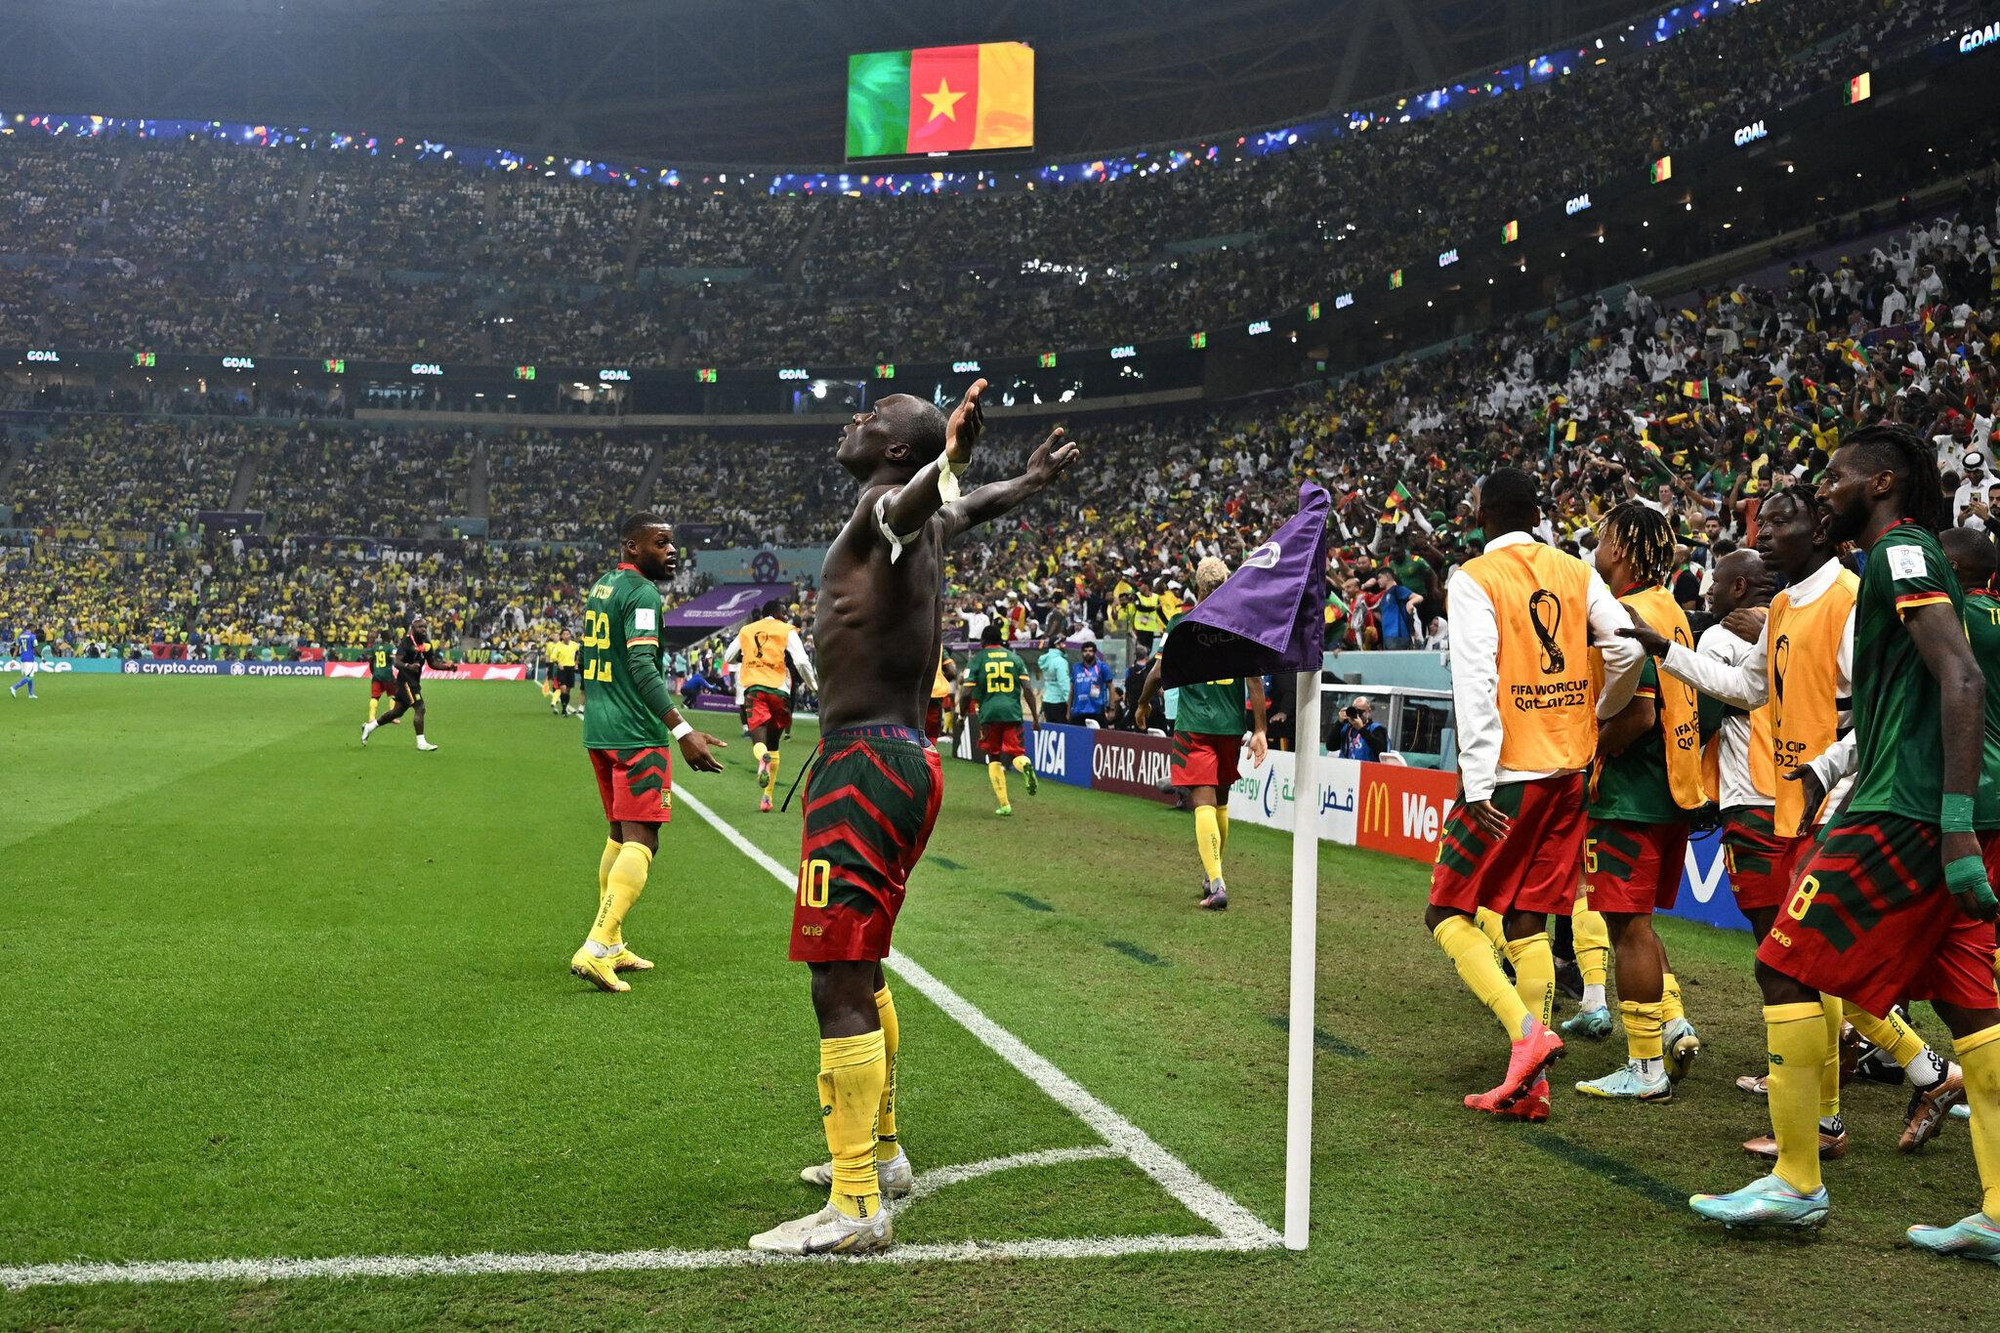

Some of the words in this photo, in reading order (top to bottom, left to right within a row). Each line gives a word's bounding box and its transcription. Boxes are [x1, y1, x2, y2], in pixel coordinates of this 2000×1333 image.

[1735, 119, 1767, 146] GOAL
[1566, 193, 1592, 215] GOAL
[1439, 249, 1460, 268] GOAL
[1335, 293, 1355, 310] GOAL
[1249, 321, 1272, 336] GOAL
[27, 350, 60, 362] GOAL
[1111, 346, 1137, 359] GOAL
[223, 356, 255, 367] GOAL
[411, 364, 444, 375] GOAL
[953, 360, 981, 372] GOAL
[599, 369, 631, 381] GOAL
[779, 369, 810, 380] GOAL
[375, 651, 387, 668] 19
[142, 662, 217, 675] crypto.com
[248, 662, 323, 676] crypto.com
[985, 661, 1015, 693] 25
[1511, 684, 1533, 695] FIFA
[1567, 680, 1589, 692] CUP
[1033, 730, 1066, 777] VISA
[1092, 743, 1135, 783] QATAR
[1136, 749, 1172, 787] AIRW
[1230, 777, 1261, 801] nergy
[1402, 791, 1438, 843] We
[801, 859, 831, 908] 10
[1787, 874, 1820, 921] 8
[802, 925, 823, 937] one
[1770, 927, 1792, 948] one
[1542, 981, 1554, 1026] CAMEROU
